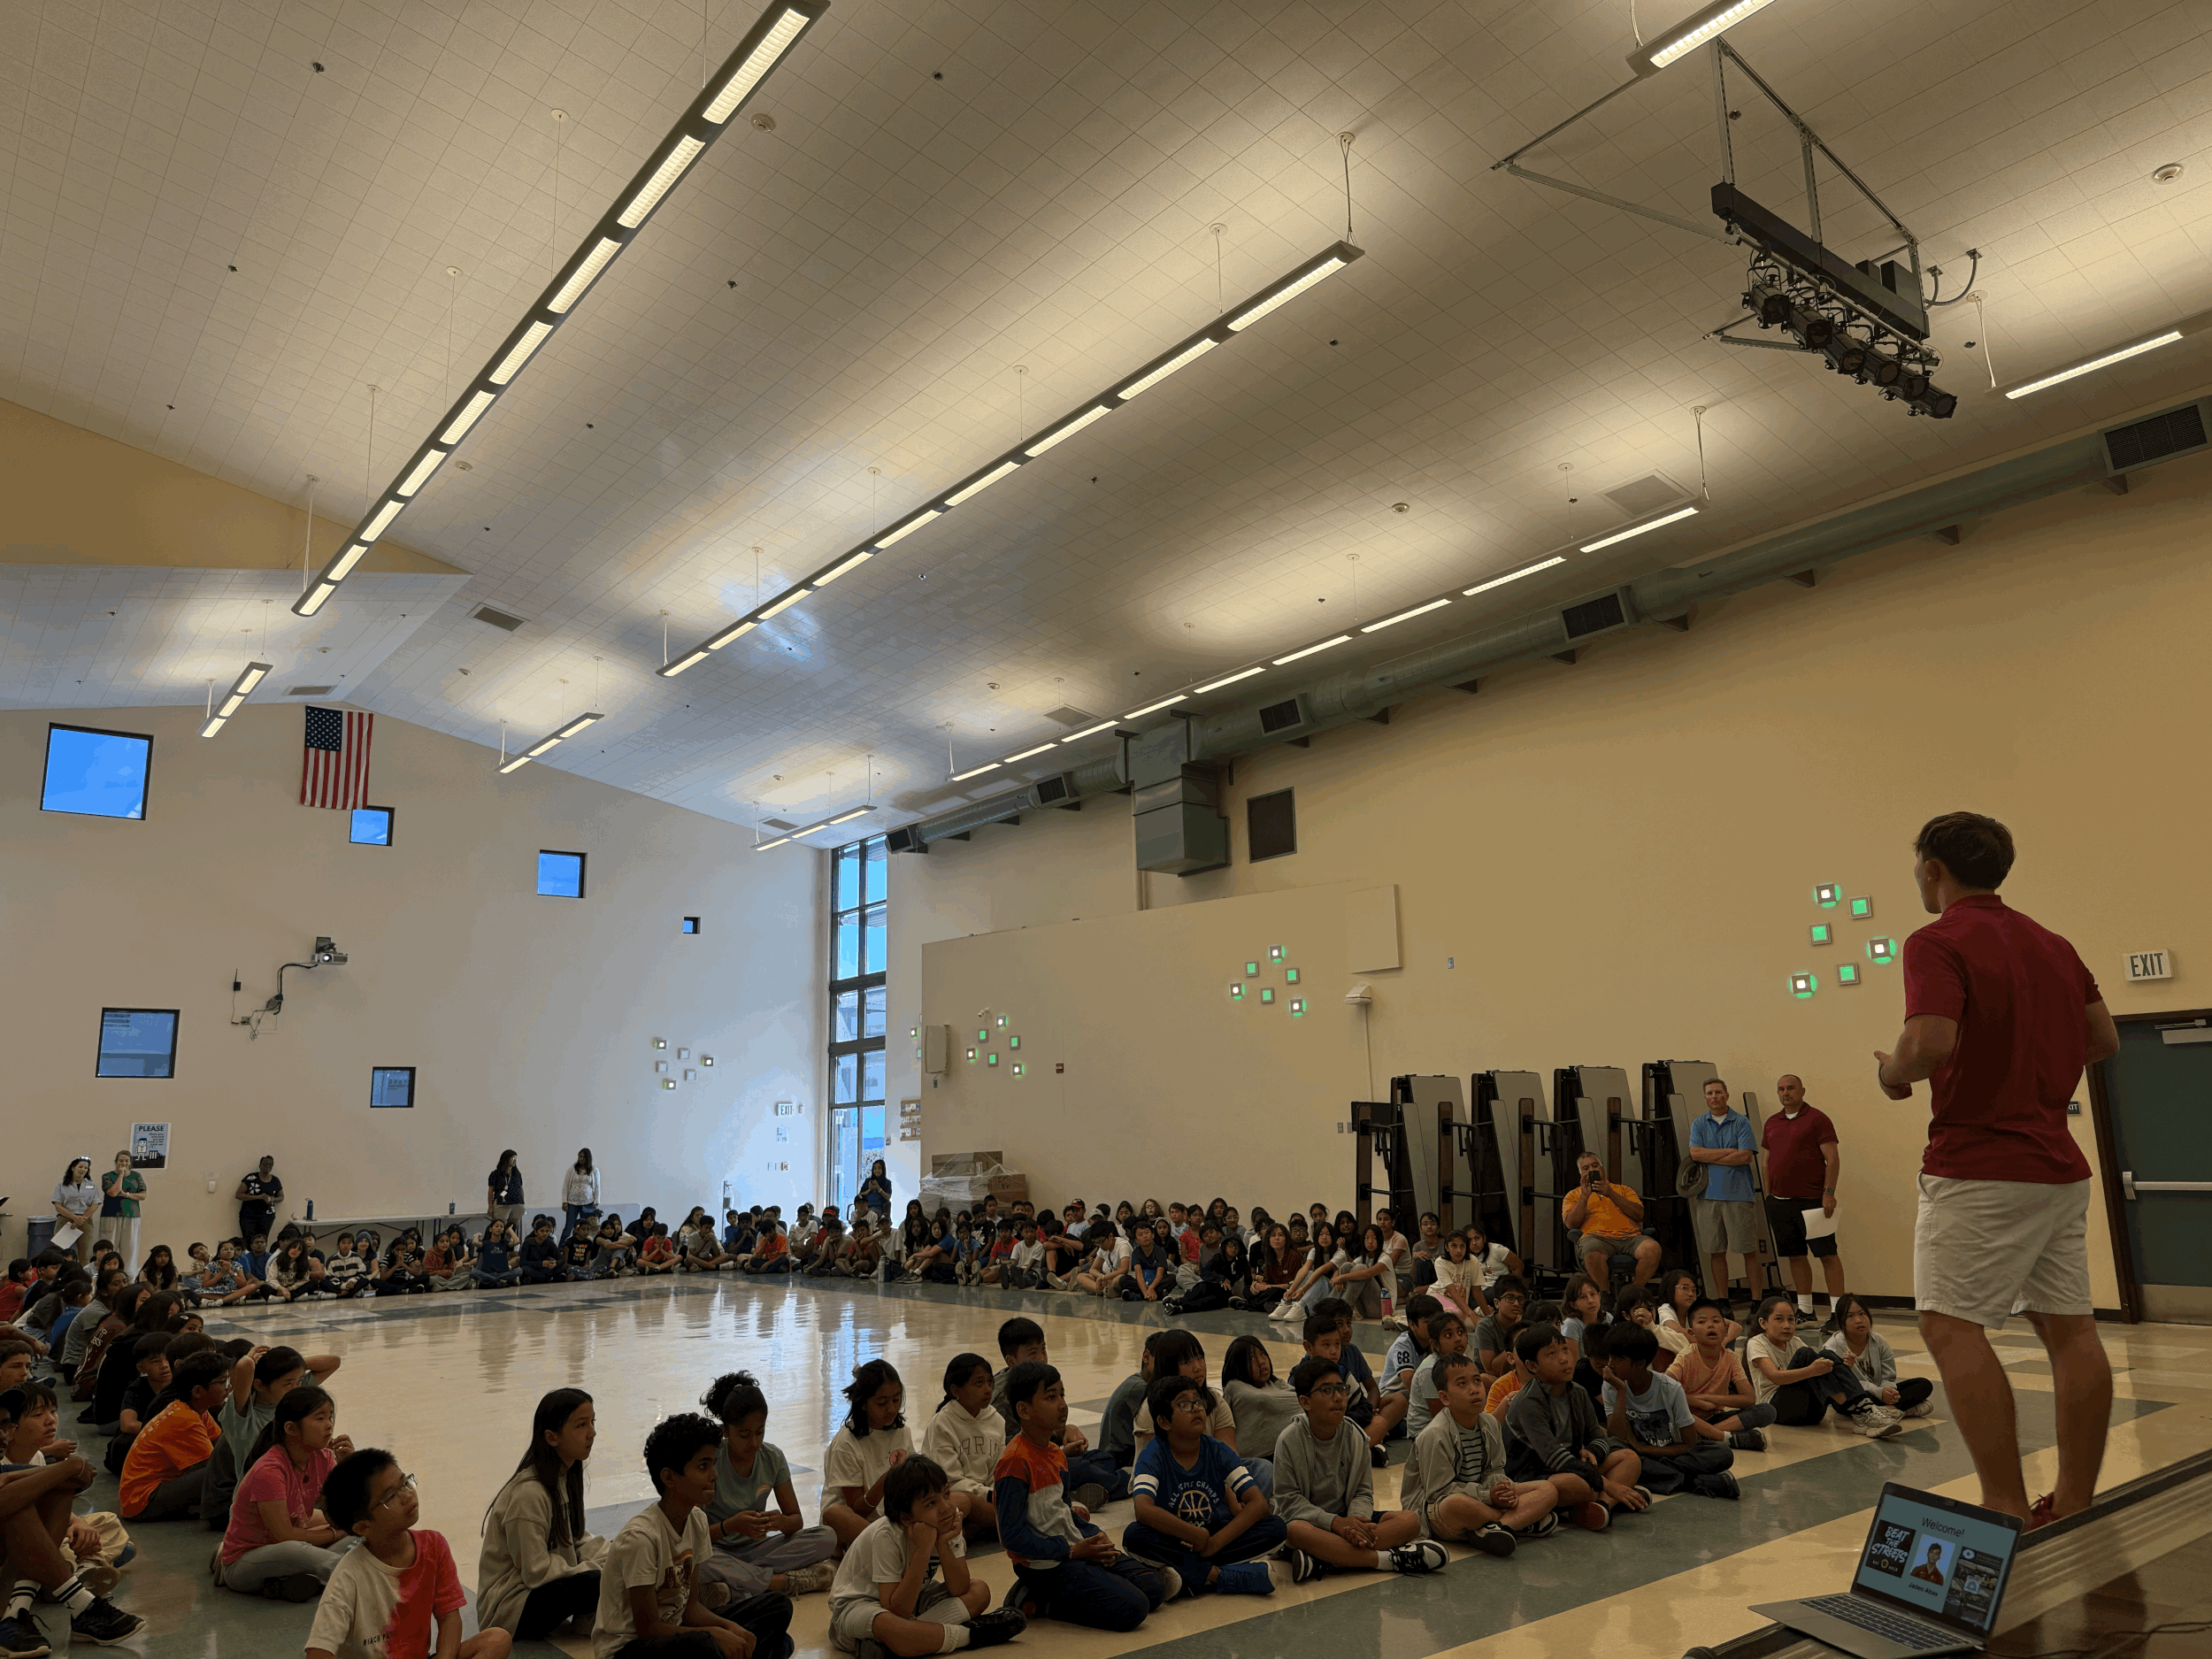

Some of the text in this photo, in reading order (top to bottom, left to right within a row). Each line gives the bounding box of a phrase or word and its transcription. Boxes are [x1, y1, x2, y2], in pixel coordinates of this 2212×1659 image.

[2130, 952, 2163, 978] EXIT
[780, 1105, 793, 1115] EXIT
[1397, 1350, 1410, 1364] 68
[1168, 1493, 1180, 1509] ALL
[1195, 1480, 1220, 1504] CHAMPS
[1885, 1525, 1910, 1542] BEAT
[1922, 1517, 1965, 1539] Welcome!
[1886, 1537, 1901, 1548] THE
[1870, 1542, 1909, 1563] STREETS
[363, 1634, 380, 1647] BEACH
